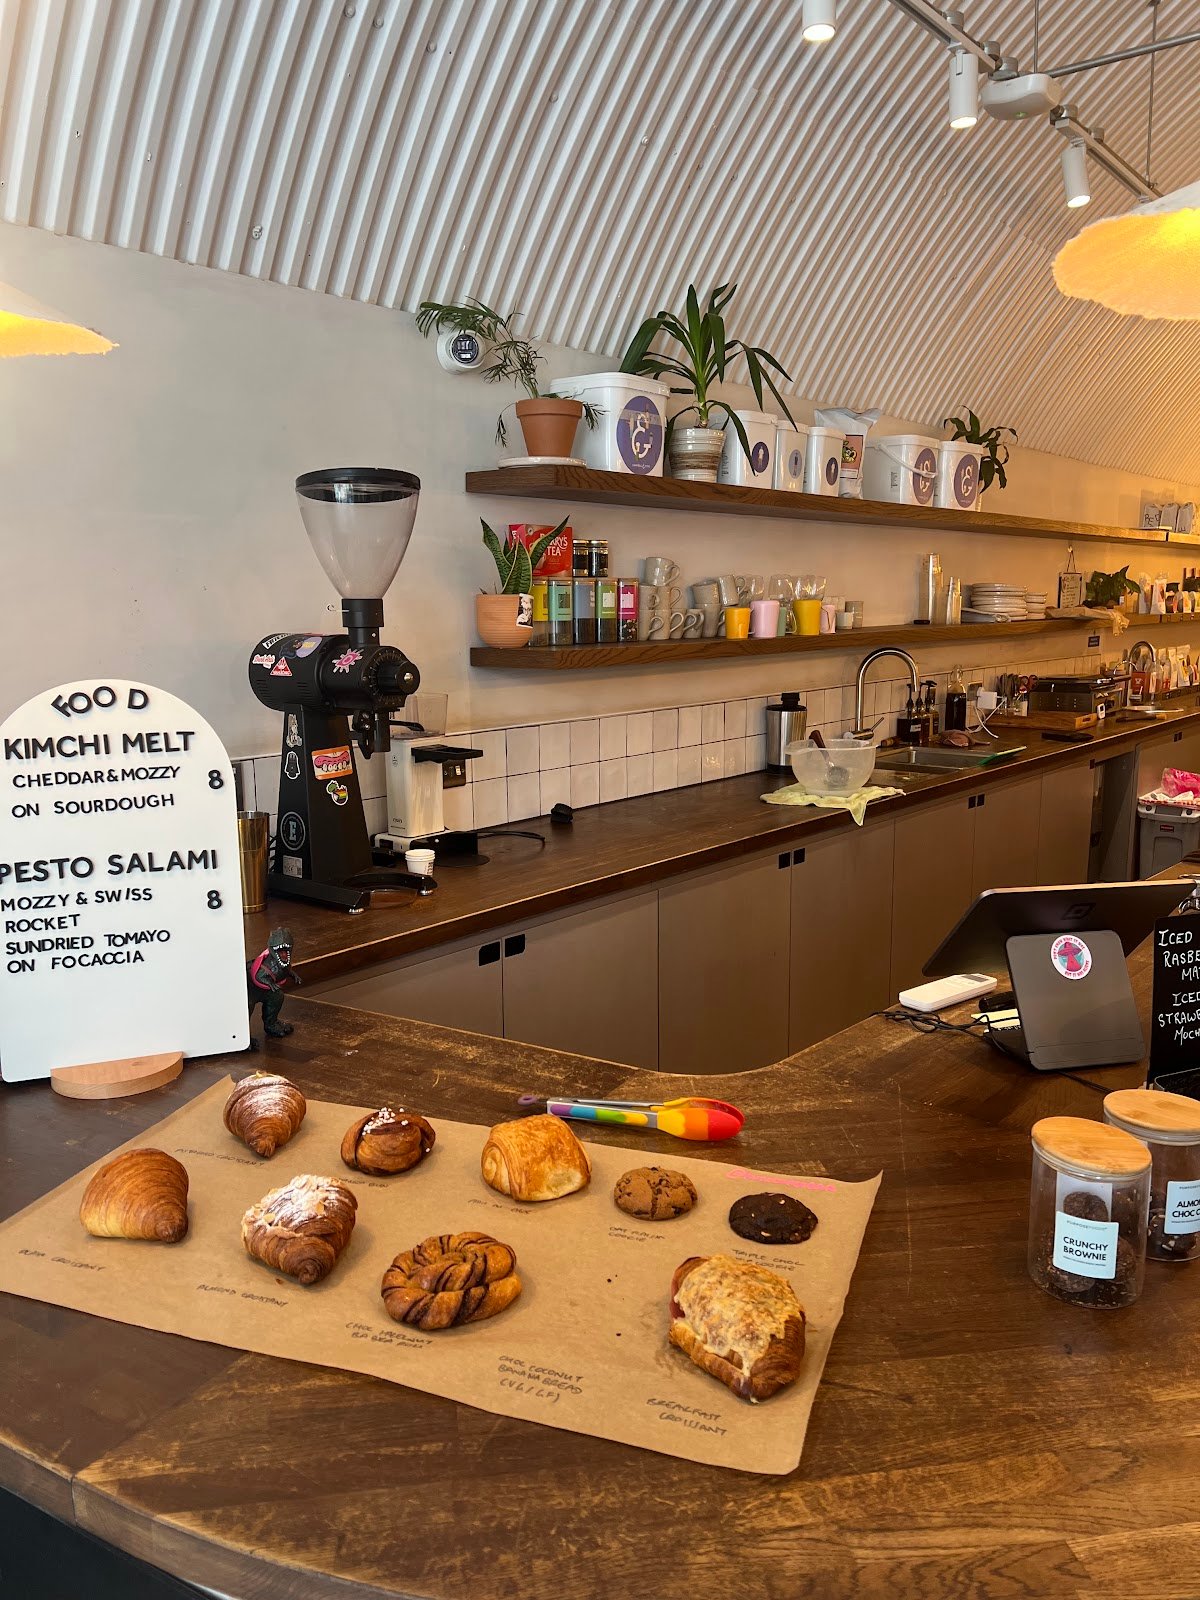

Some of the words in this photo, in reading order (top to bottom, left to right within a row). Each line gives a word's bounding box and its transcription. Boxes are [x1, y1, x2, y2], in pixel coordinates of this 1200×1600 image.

[547, 546, 561, 556] TEA
[51, 686, 149, 717] FOOD
[4, 733, 110, 760] KIMCHI
[122, 731, 195, 753] MELT
[208, 769, 224, 789] 8
[11, 803, 40, 818] ON
[54, 794, 175, 814] SOURDOUGH
[0, 856, 94, 884] PESTO
[107, 849, 218, 876] SALAMI
[1, 893, 70, 912] MOZZY
[75, 891, 88, 905] &
[94, 887, 153, 904] SWISS
[207, 890, 222, 910] 8
[5, 914, 81, 934] ROCKET
[5, 936, 94, 955] SUNDRIED
[104, 929, 170, 948] TOMAYO
[1158, 929, 1193, 946] ICED
[7, 959, 35, 974] ON
[51, 950, 144, 970] FOCACCIA
[1163, 950, 1200, 968] RASBE
[1182, 966, 1200, 981] MA
[1176, 1199, 1200, 1208] ALMO
[1172, 1210, 1195, 1218] CHOC
[1063, 1236, 1108, 1251] CRUNCHY
[1063, 1246, 1107, 1261] BROWNIE
[732, 1249, 766, 1260] TRIPLE
[499, 1355, 526, 1367] CHOC
[528, 1365, 584, 1382] COCONUT
